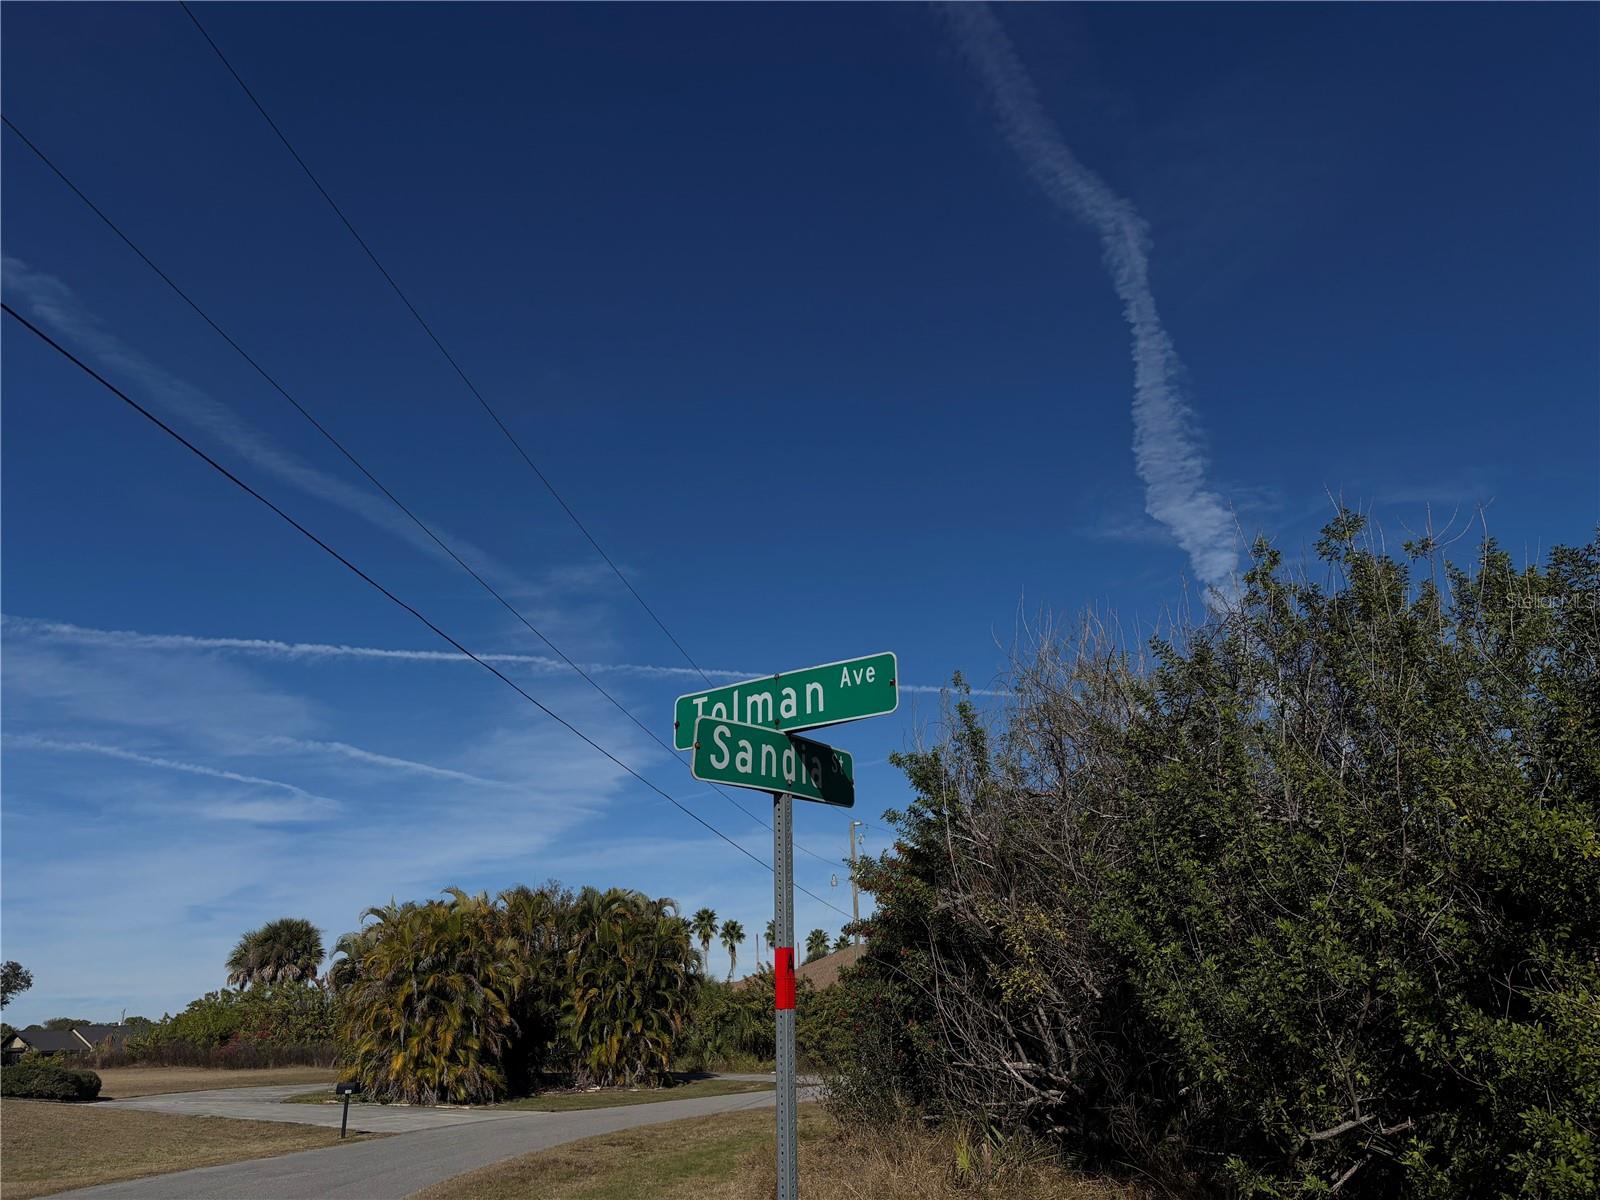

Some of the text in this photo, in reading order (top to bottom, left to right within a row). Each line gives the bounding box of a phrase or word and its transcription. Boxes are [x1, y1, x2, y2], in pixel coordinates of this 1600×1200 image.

[840, 666, 876, 688] Ave
[710, 725, 844, 788] Sandia St
